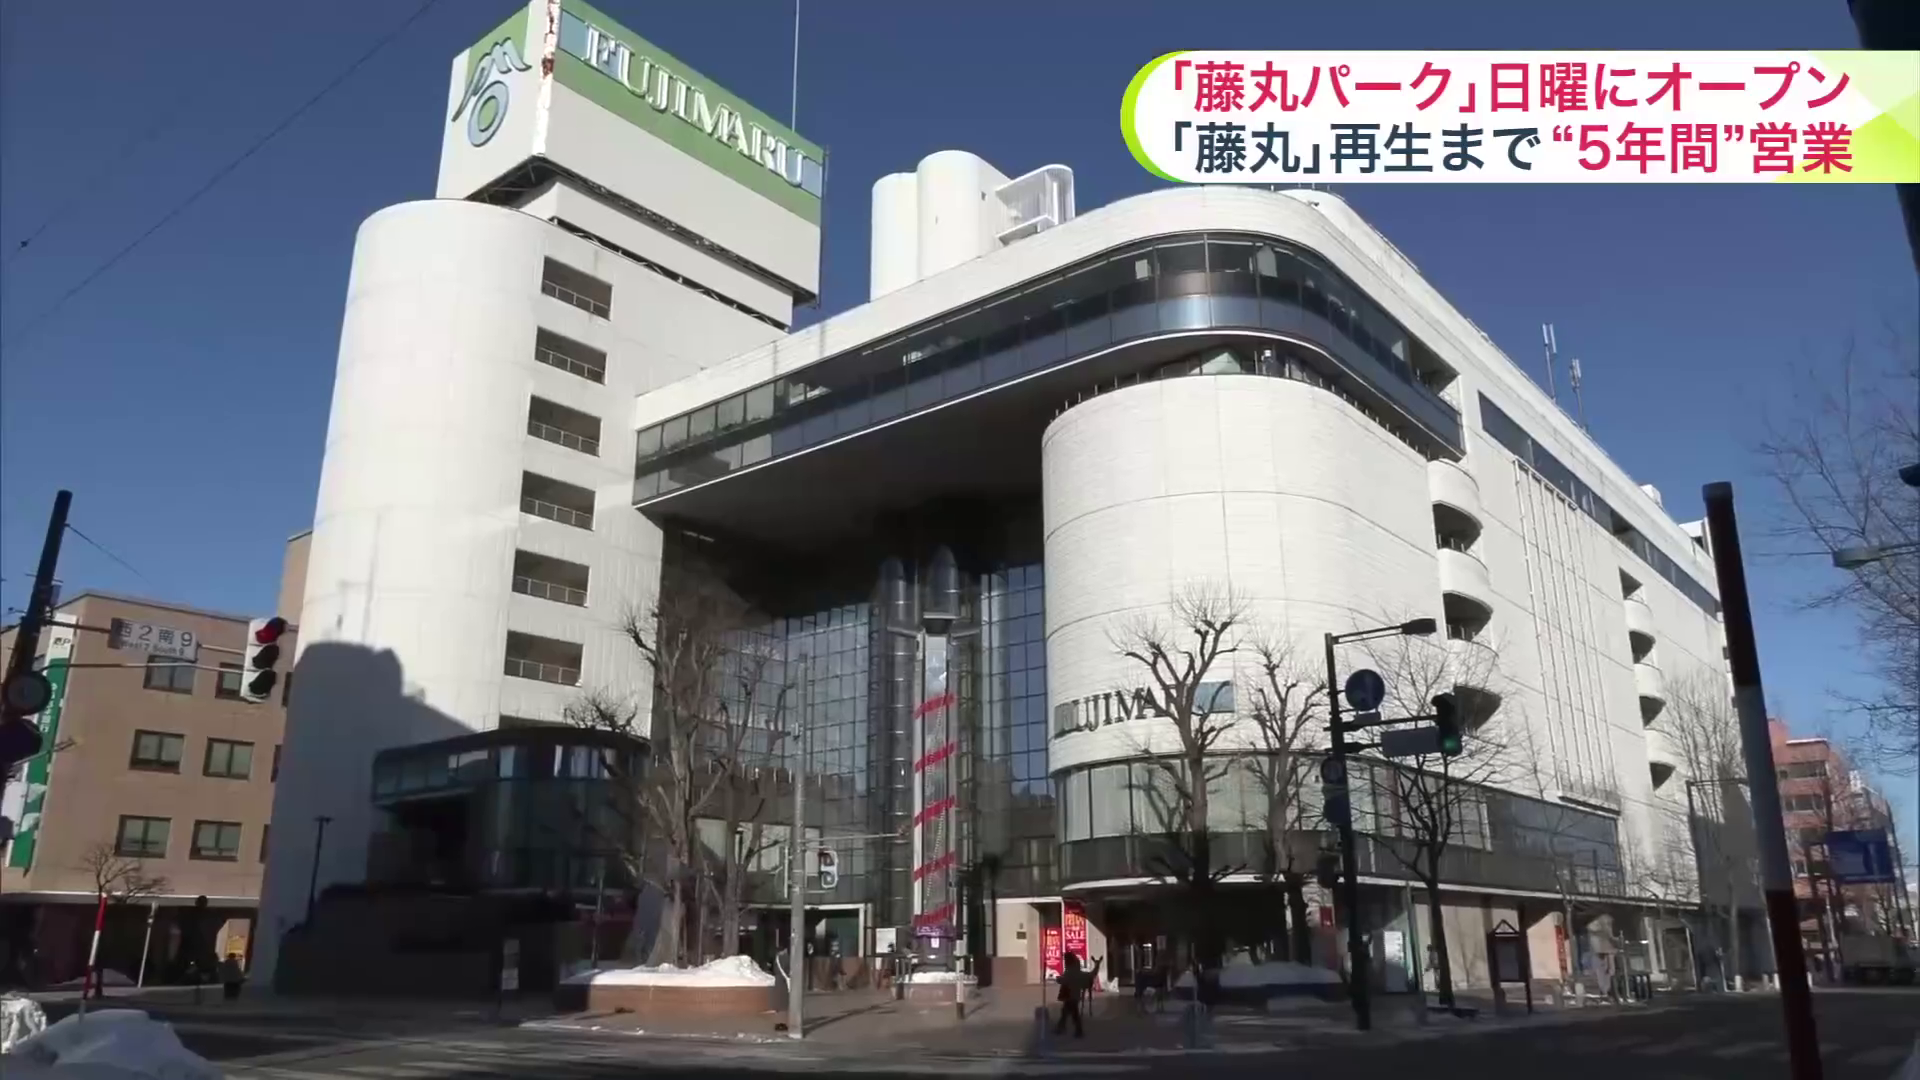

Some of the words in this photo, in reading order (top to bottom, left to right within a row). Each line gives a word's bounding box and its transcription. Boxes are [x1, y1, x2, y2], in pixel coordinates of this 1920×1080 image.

[583, 21, 805, 188] FUJIMARU
[1055, 684, 1190, 738] UJIMA
[1066, 930, 1086, 940] SALE
